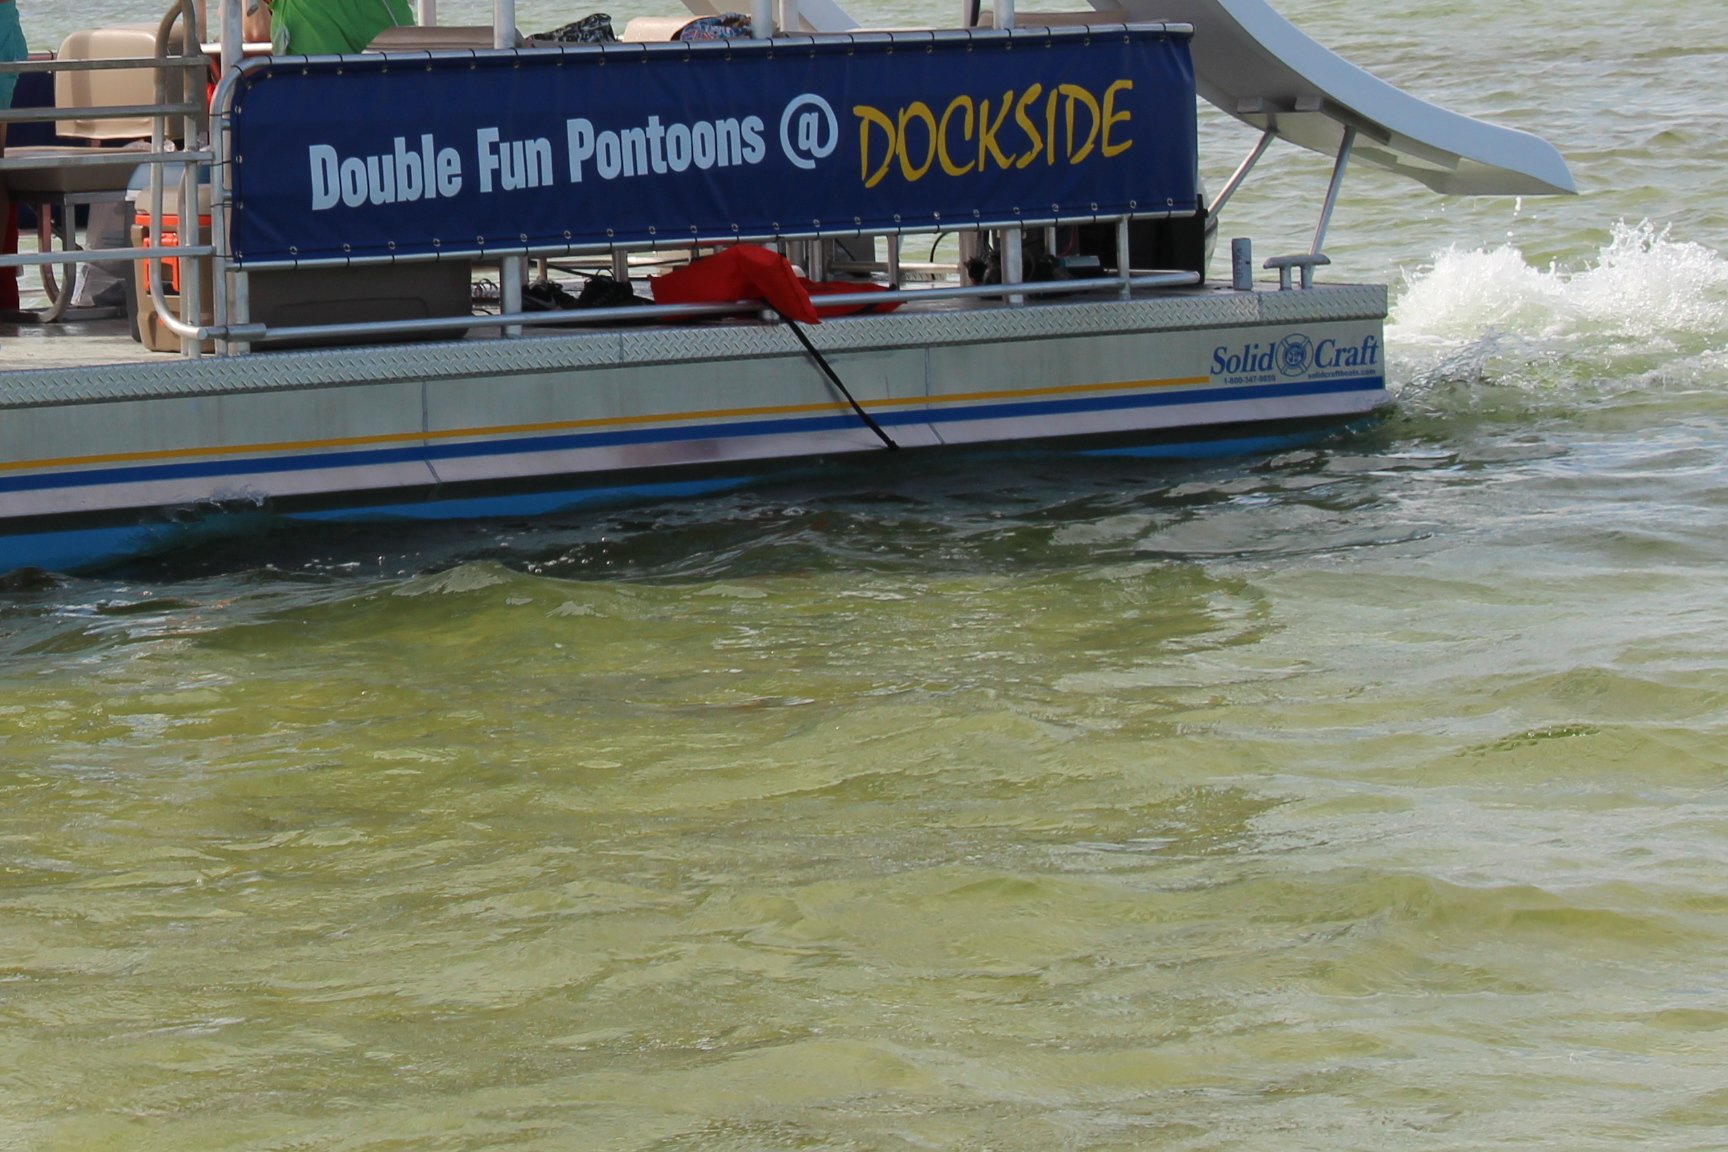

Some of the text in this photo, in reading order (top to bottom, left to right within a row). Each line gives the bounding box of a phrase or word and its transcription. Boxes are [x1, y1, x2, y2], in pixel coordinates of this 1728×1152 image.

[309, 79, 1133, 210] Double Fun Pontoons @ DOCKSIDE
[1209, 335, 1378, 375] Solid Craft
